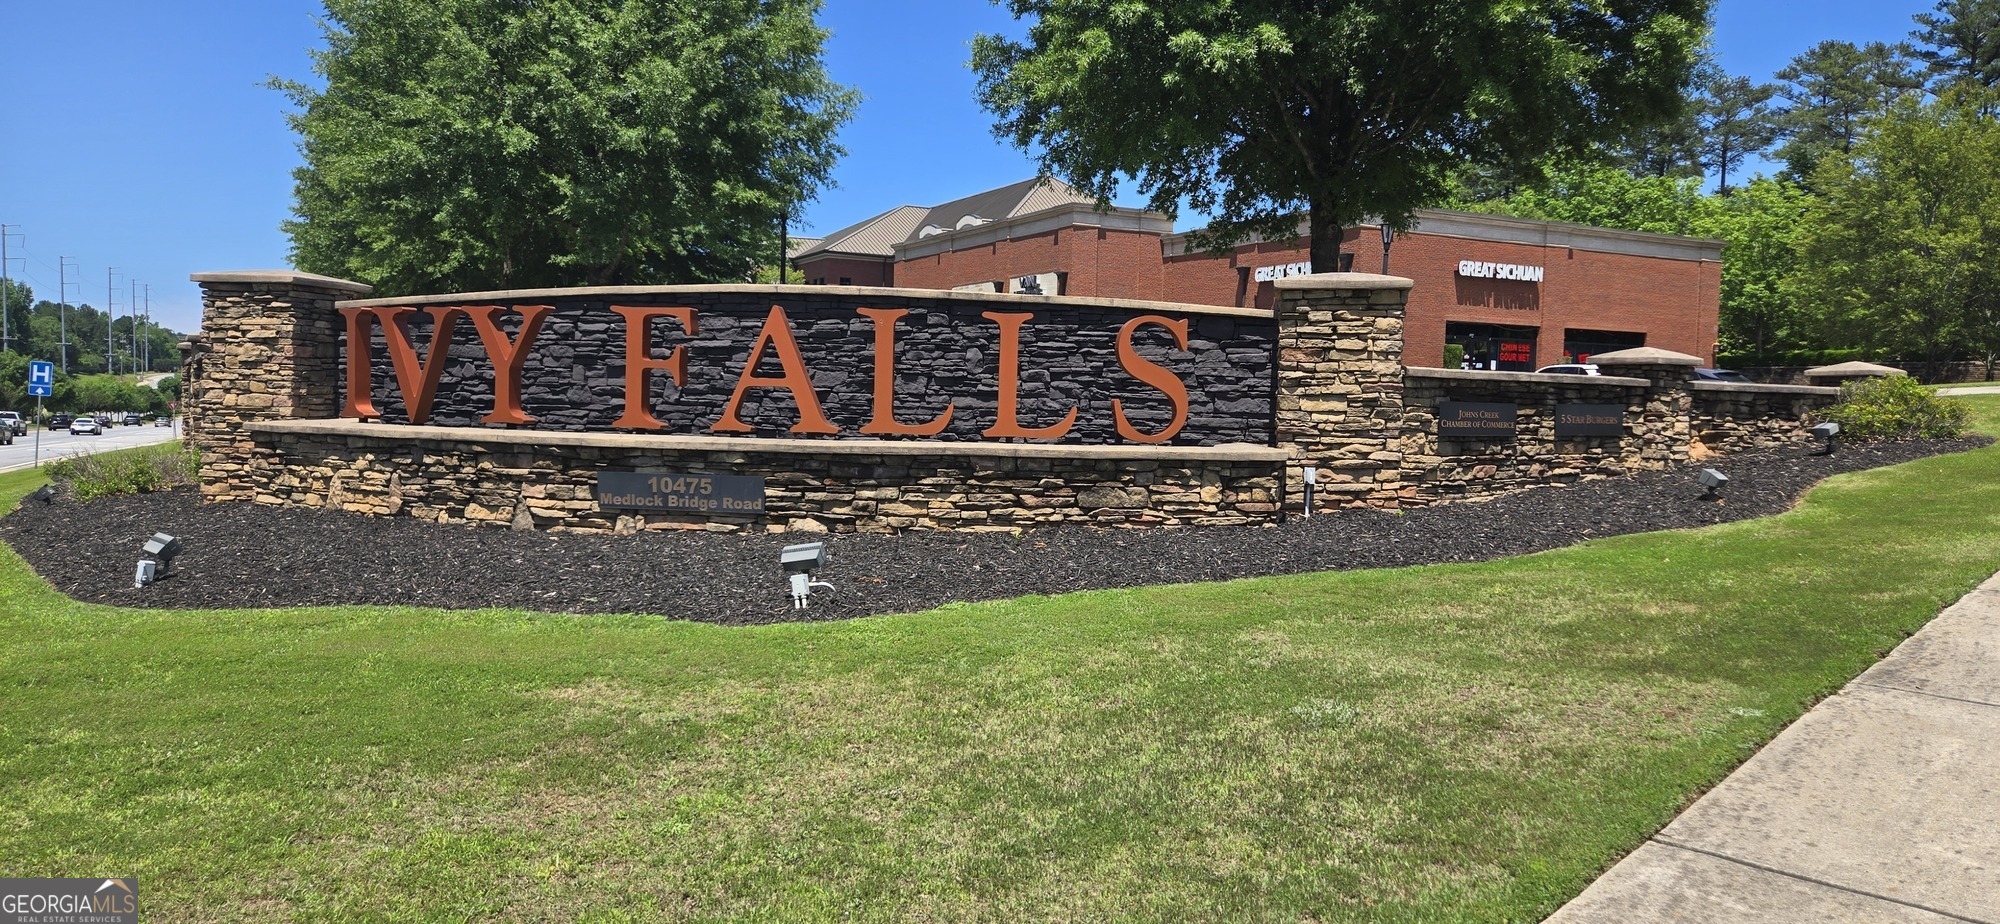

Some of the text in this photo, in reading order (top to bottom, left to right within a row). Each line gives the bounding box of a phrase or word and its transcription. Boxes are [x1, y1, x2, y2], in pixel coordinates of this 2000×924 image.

[1254, 261, 1312, 282] GREAT SICH
[1458, 260, 1544, 282] GREAT SICHUAN
[32, 365, 50, 382] H
[338, 304, 1189, 444] IVY FALLS
[1458, 410, 1499, 420] JOHNS CREEK
[1561, 414, 1618, 425] 5 STAR BURGERS
[1441, 420, 1472, 428] CHAMBER
[1481, 420, 1515, 429] COMMERCE
[648, 477, 713, 495] 10475
[600, 493, 762, 511] Medlock Bridge Road
